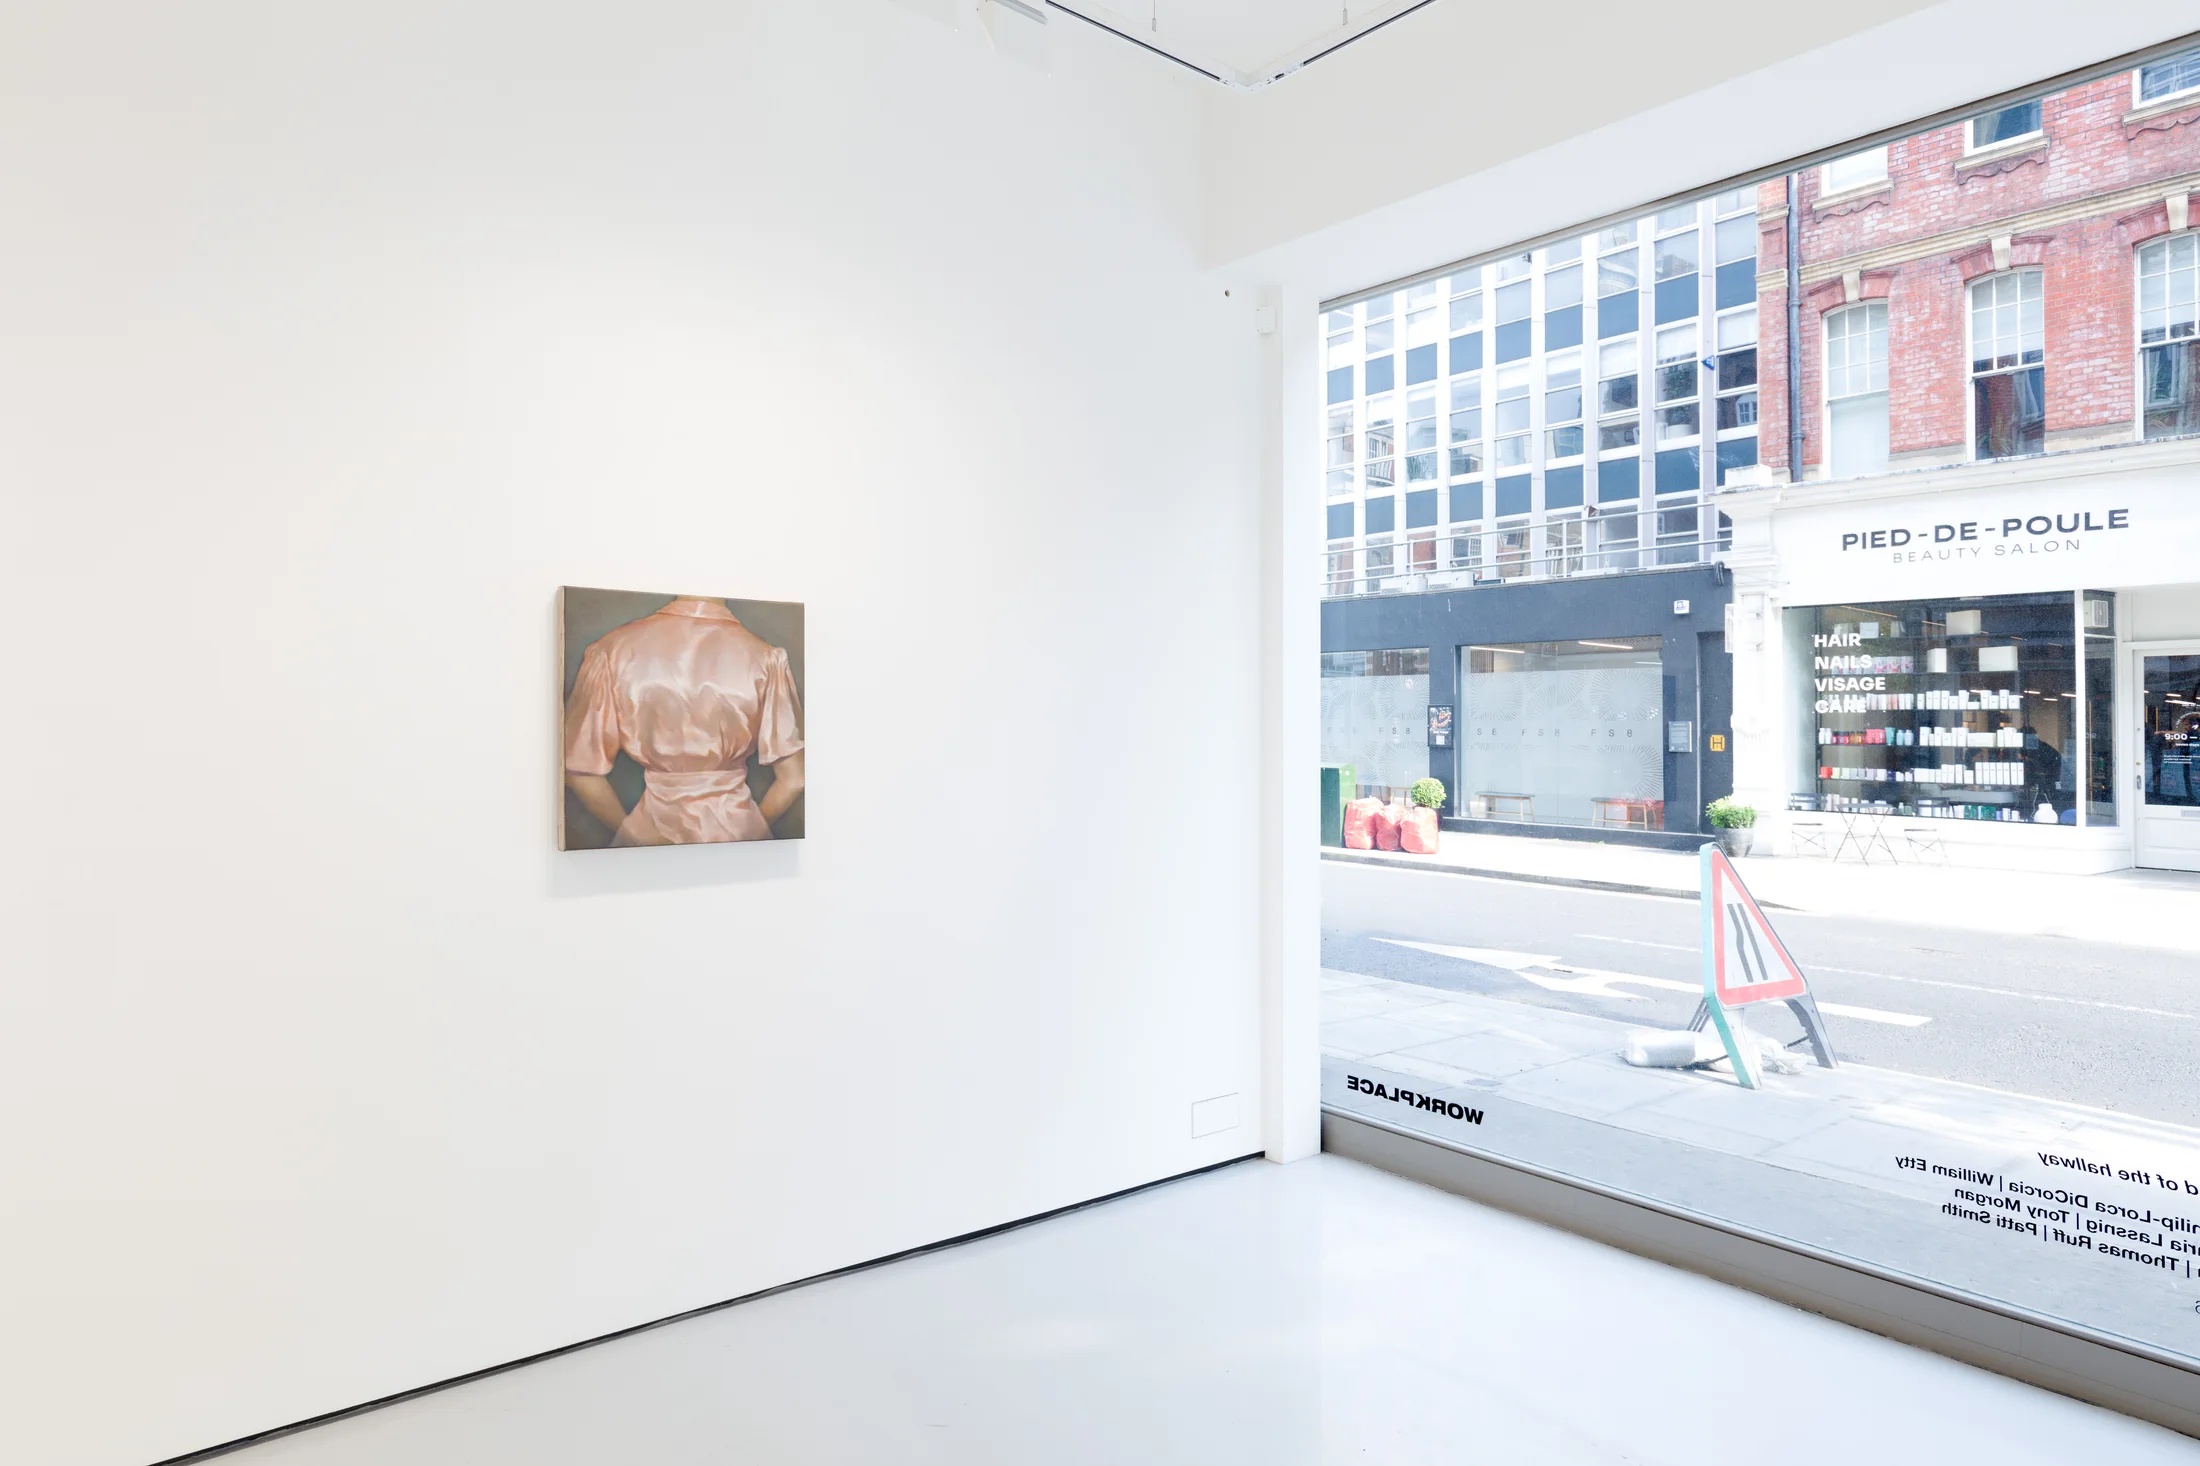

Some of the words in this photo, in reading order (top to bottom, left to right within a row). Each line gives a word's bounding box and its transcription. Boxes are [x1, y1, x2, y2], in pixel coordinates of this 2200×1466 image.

[1893, 547, 1982, 563] BEAUTY
[1994, 539, 2080, 556] SALON
[1814, 633, 1861, 648] HAIR
[1814, 654, 1872, 669] NAILS
[1814, 677, 1886, 692] VISAGE
[1815, 699, 1867, 714] CARE
[2164, 733, 2188, 741] 9:00
